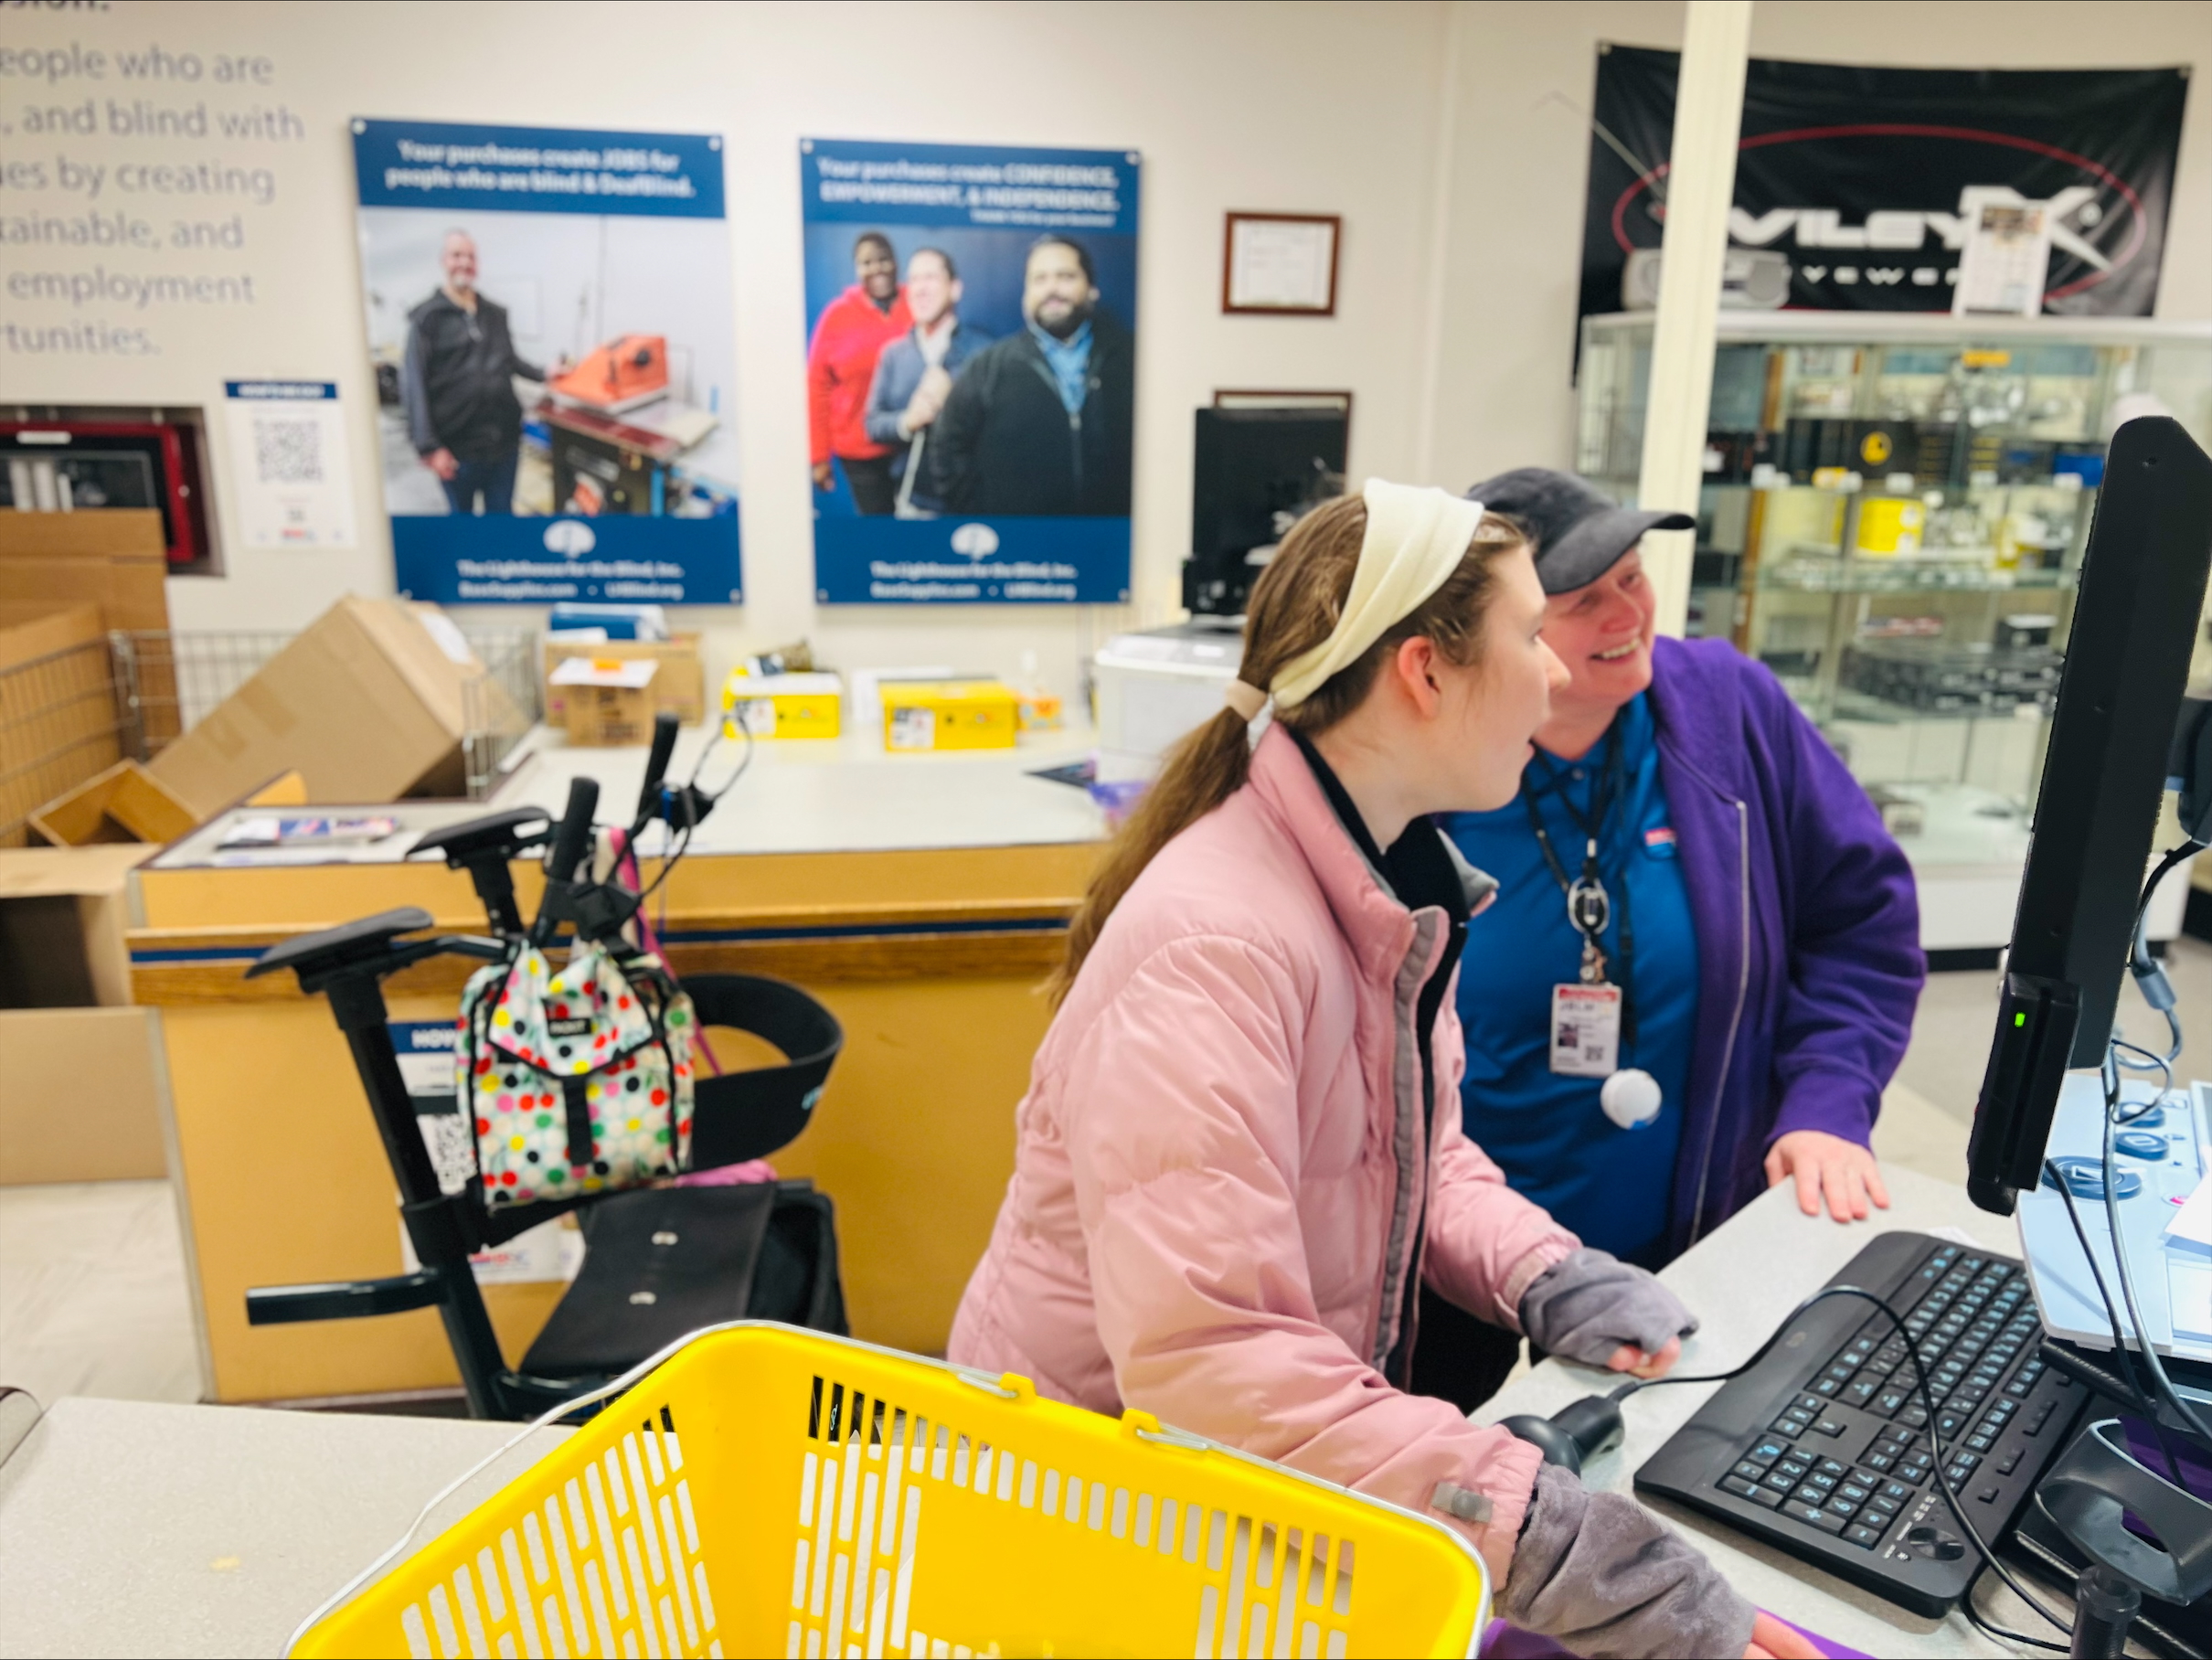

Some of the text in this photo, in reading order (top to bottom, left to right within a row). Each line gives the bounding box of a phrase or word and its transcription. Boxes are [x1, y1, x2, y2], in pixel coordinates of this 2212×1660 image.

[117, 45, 204, 80] who
[213, 55, 274, 84] are
[23, 100, 304, 141] and blind with
[398, 140, 445, 162] Your
[446, 142, 540, 166] purchases
[542, 148, 601, 170] create
[649, 149, 680, 173] for
[816, 157, 860, 178] Your
[0, 154, 275, 205] es by creating
[385, 165, 453, 190] people
[454, 168, 497, 190] who
[498, 173, 529, 191] are
[529, 170, 582, 194] blind
[171, 215, 243, 250] and
[6, 265, 255, 309] employment
[0, 321, 161, 355] tunities.
[1763, 1444, 1780, 1455] 0
[1795, 1451, 1813, 1460] 1
[1782, 1463, 1802, 1474] 2
[1824, 1462, 1842, 1472] 4
[1771, 1475, 1789, 1486] 3
[1814, 1474, 1833, 1485] 5
[1856, 1474, 1874, 1484] 7
[1802, 1488, 1819, 1499] 6
[1845, 1486, 1863, 1497] 8
[1834, 1501, 1852, 1512] 9
